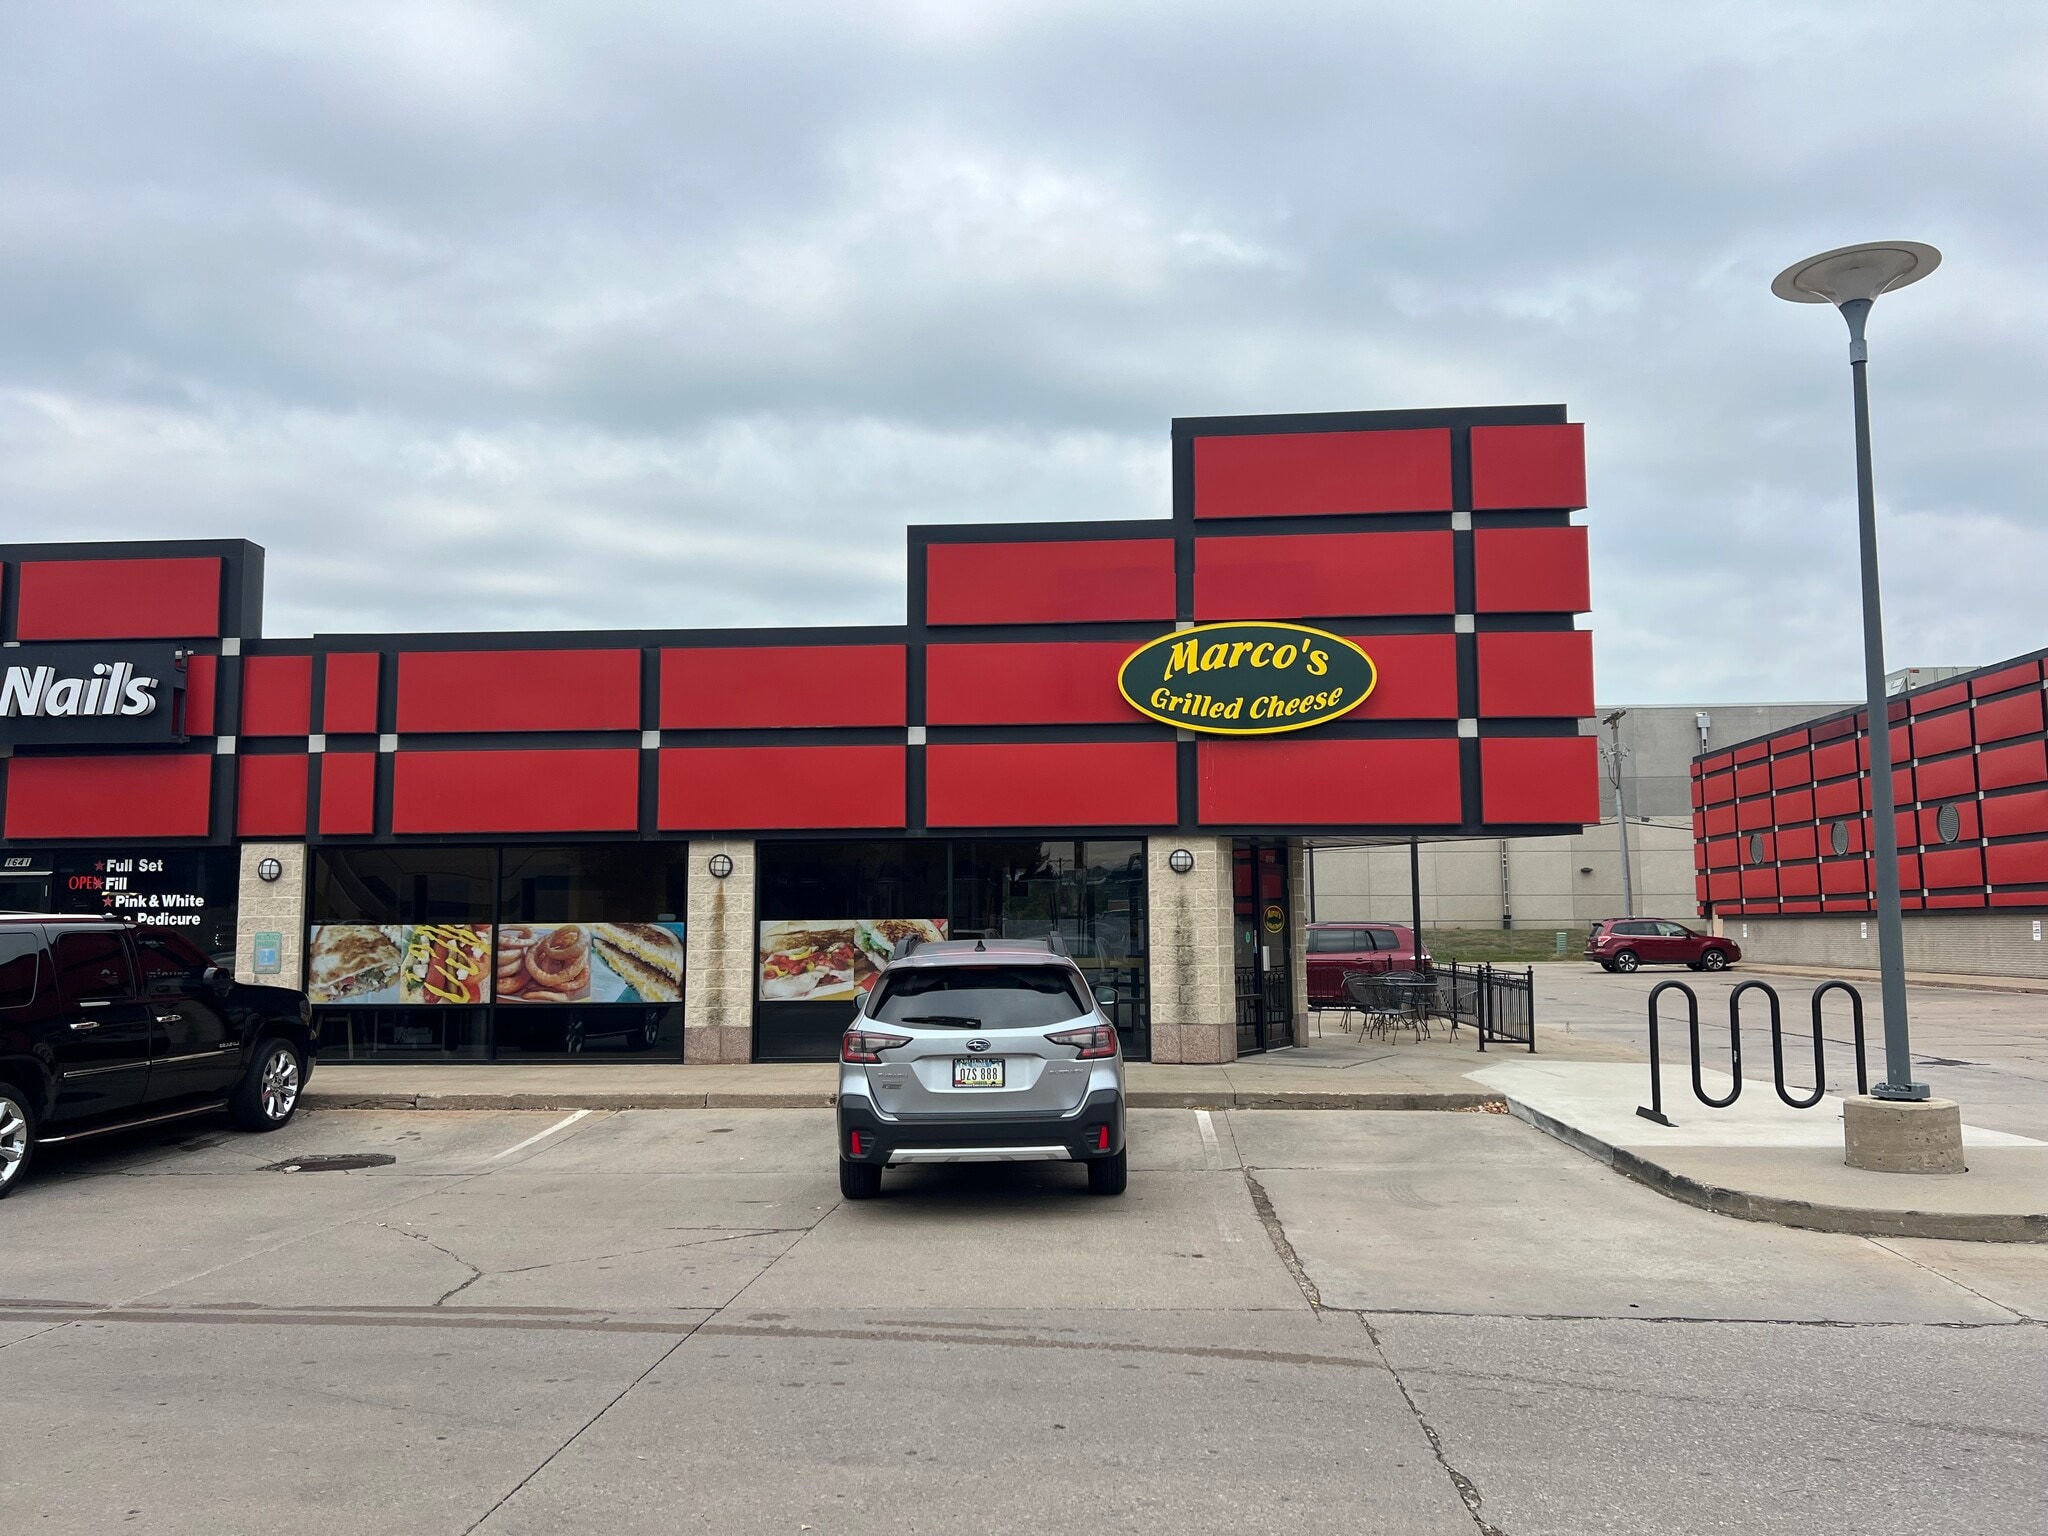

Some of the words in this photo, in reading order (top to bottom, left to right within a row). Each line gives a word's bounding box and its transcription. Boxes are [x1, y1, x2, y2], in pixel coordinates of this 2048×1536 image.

[1163, 638, 1330, 682] Marco's
[0, 661, 158, 717] Nails
[1150, 687, 1244, 720] Grilled
[1249, 687, 1344, 720] Cheese
[106, 859, 133, 872] Full
[138, 858, 164, 872] Set
[105, 877, 128, 891] Fill
[115, 894, 147, 908] Pink
[148, 894, 160, 908] &
[161, 894, 205, 907] White
[137, 912, 201, 926] Pedicure
[980, 1067, 998, 1081] 888
